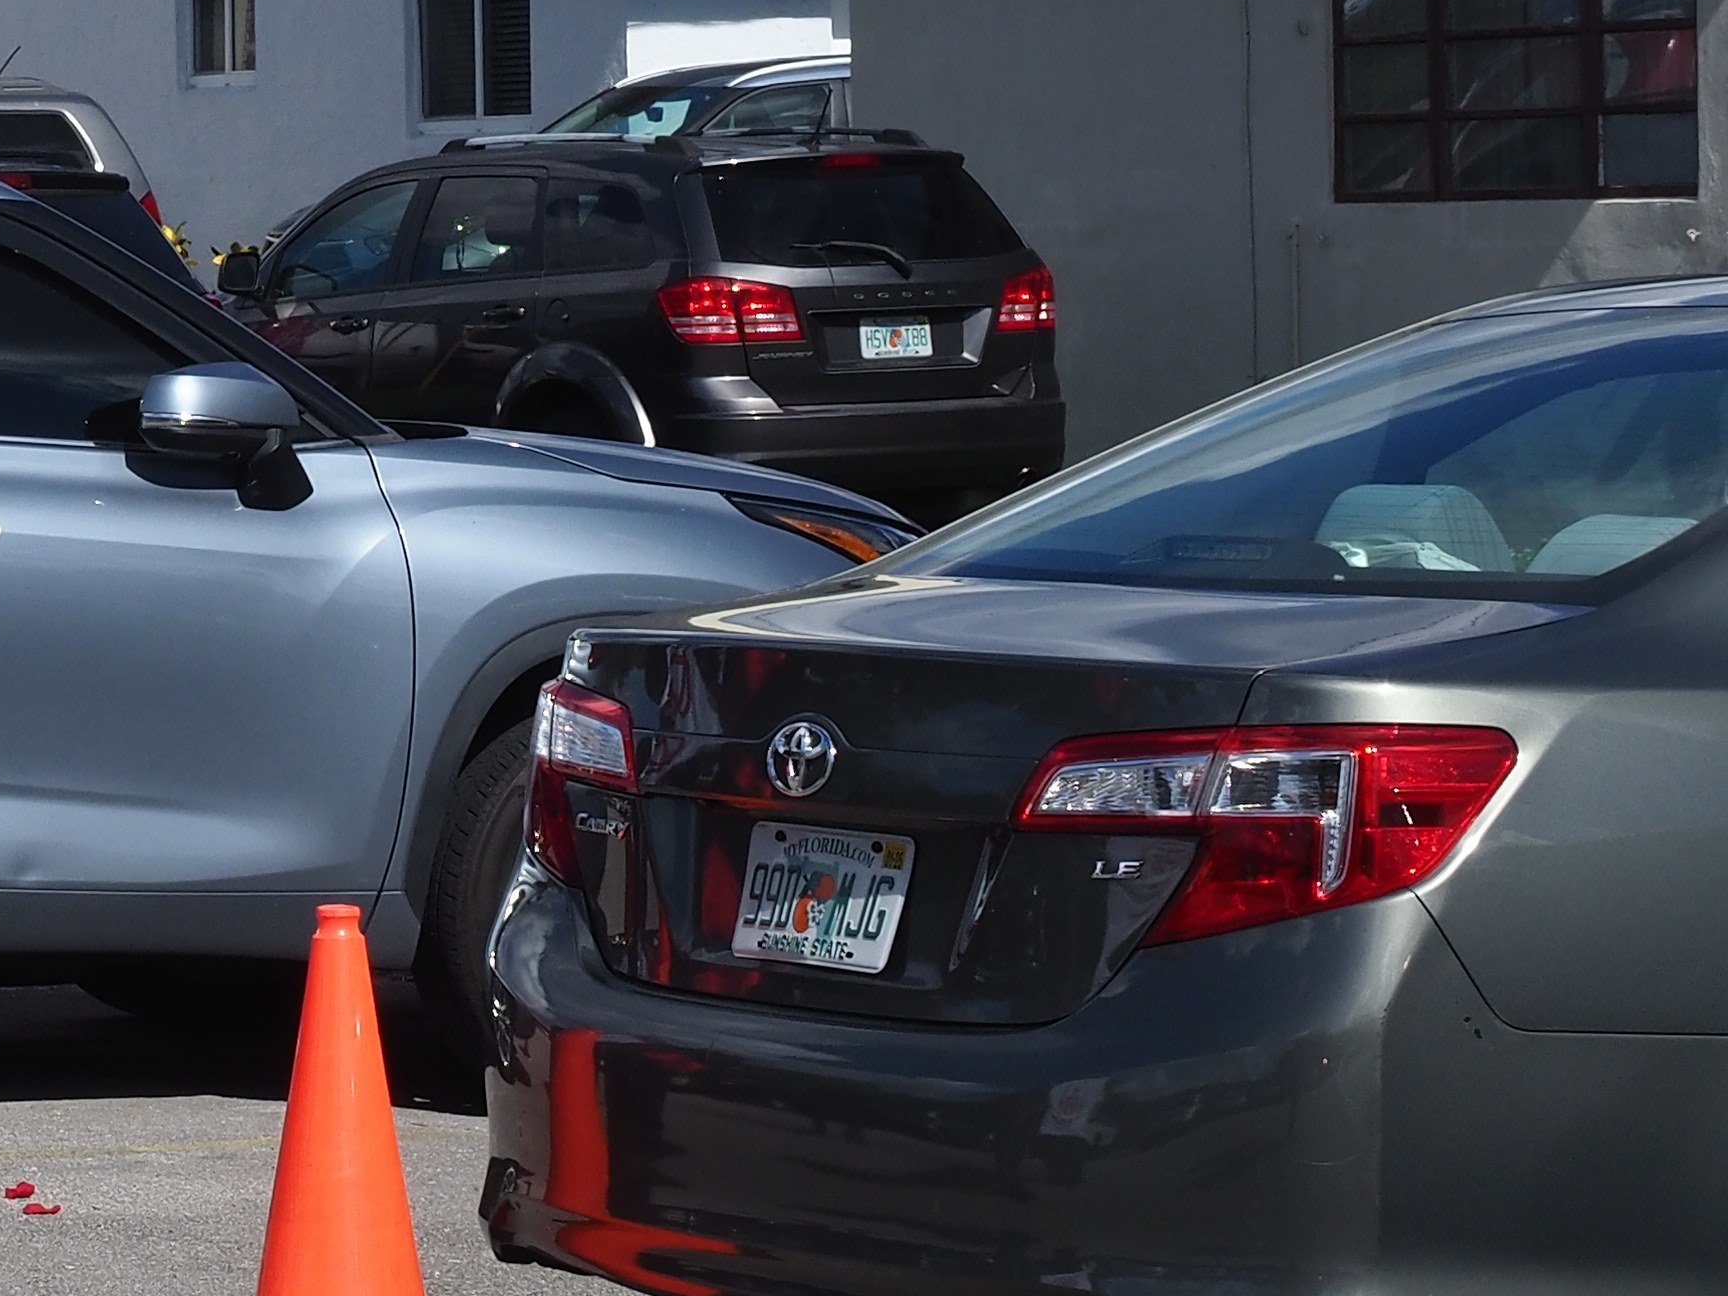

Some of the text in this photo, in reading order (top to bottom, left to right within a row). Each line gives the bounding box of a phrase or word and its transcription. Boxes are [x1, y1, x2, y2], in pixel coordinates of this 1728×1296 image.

[1091, 861, 1144, 879] LE
[824, 872, 895, 941] MJG
[810, 938, 848, 961] STATE
